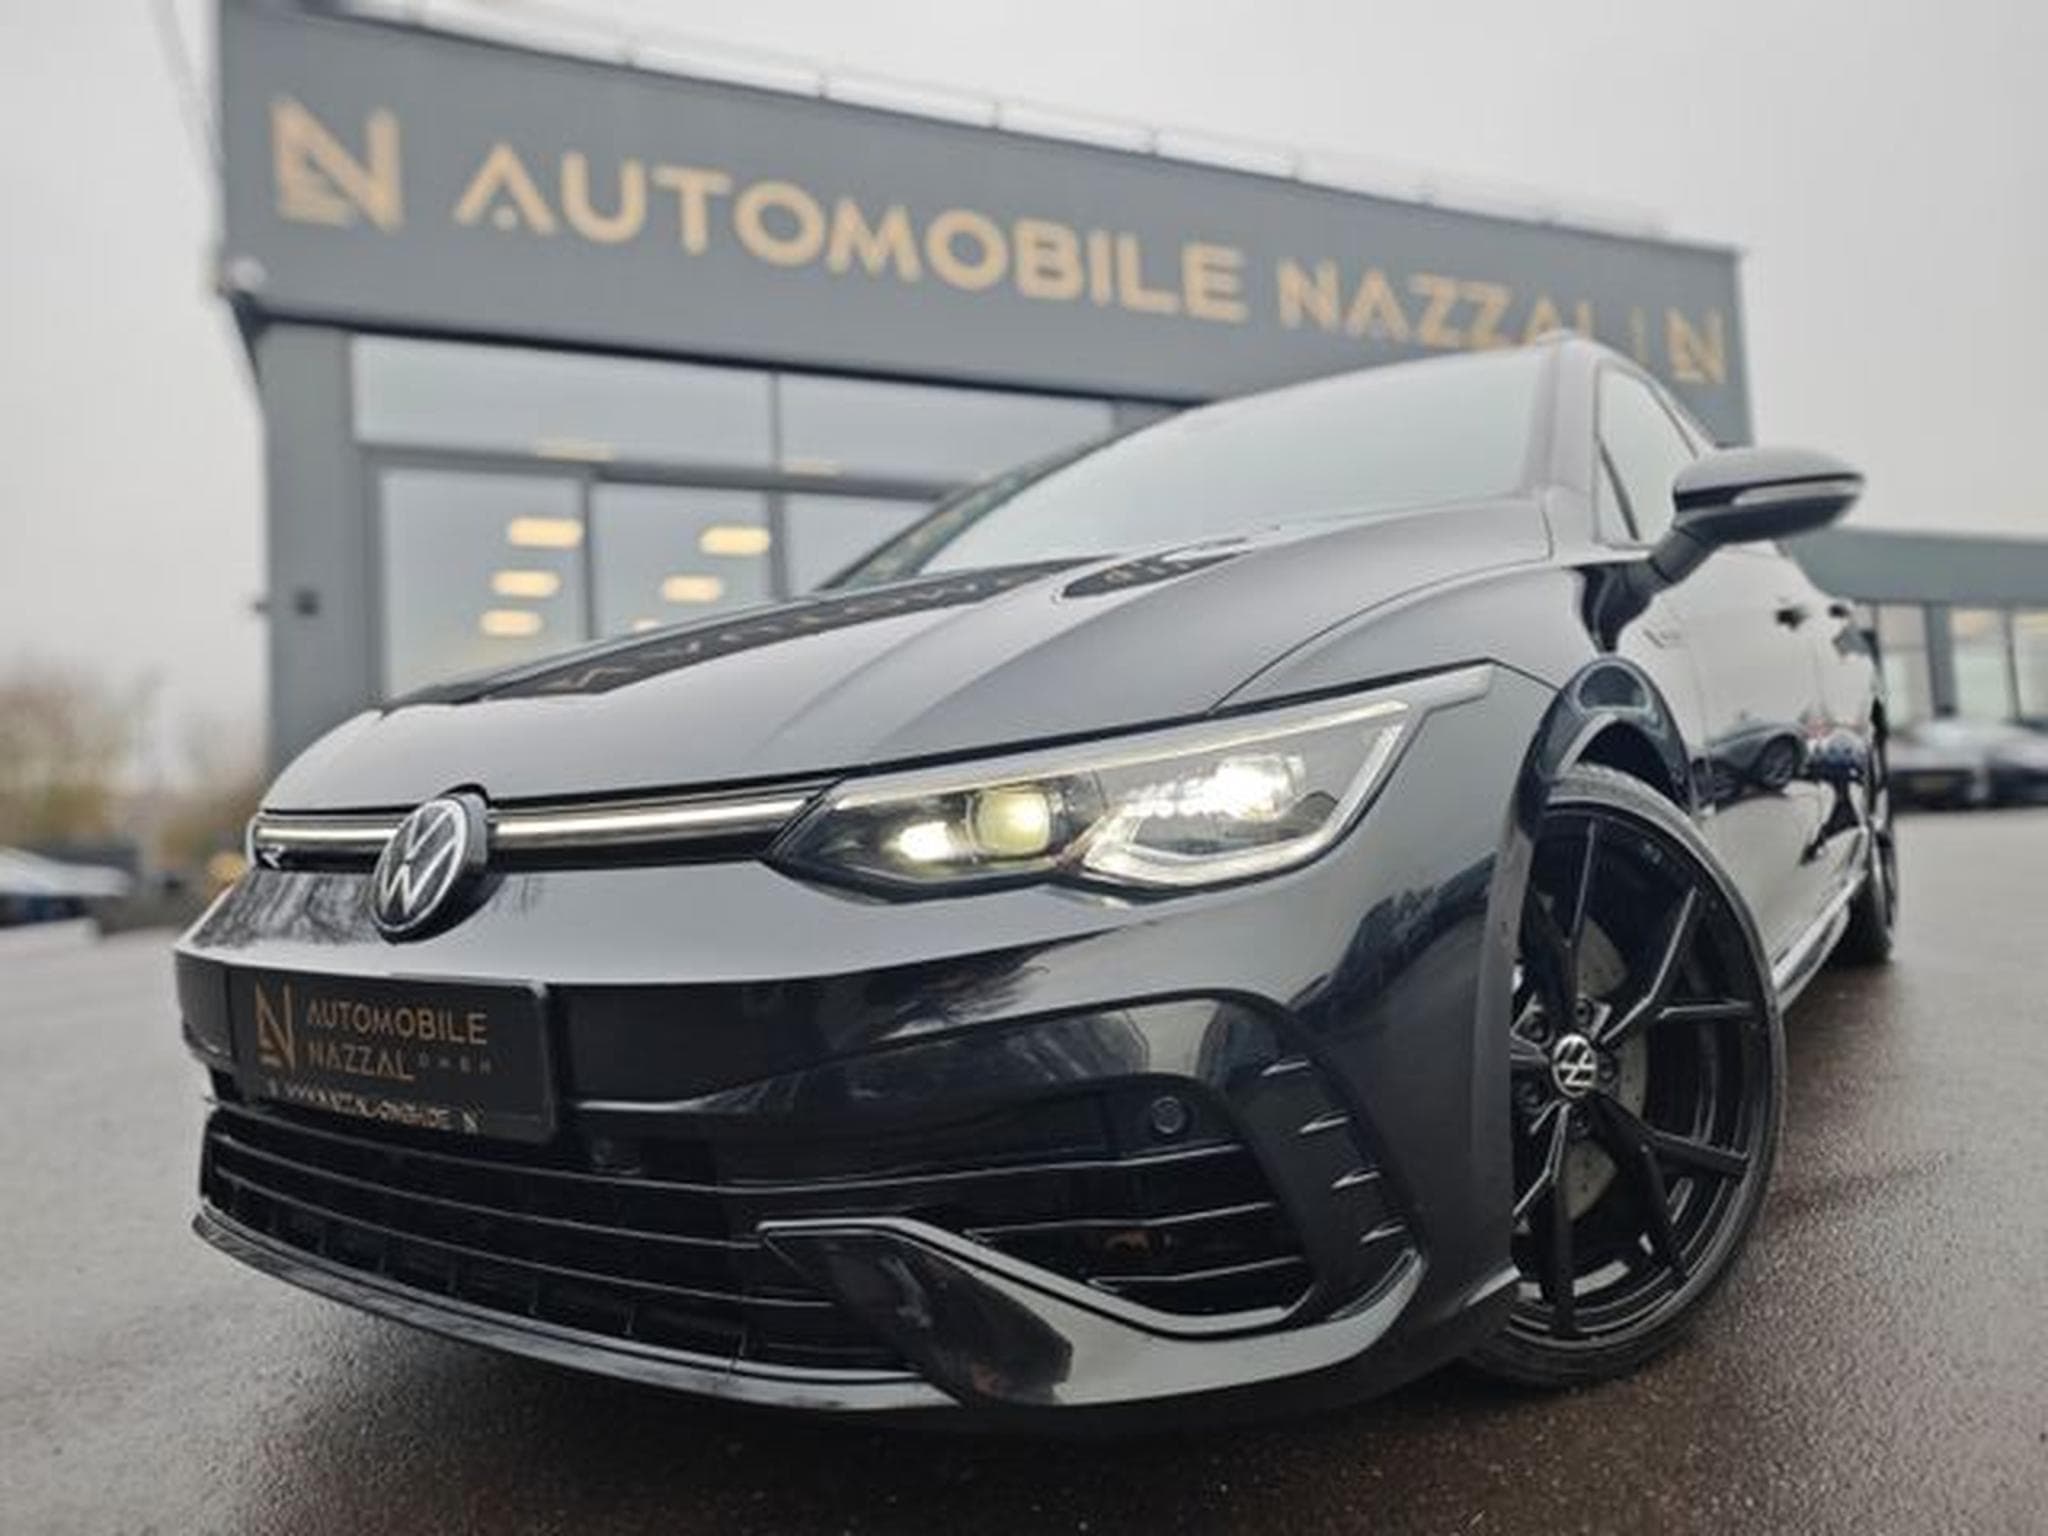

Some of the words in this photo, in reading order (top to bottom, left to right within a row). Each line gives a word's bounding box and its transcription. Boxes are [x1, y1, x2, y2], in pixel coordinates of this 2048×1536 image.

[453, 141, 1246, 323] AUTOMOBILE
[306, 999, 488, 1046] AUTOMOBILE
[307, 1039, 416, 1082] NAZZAL
